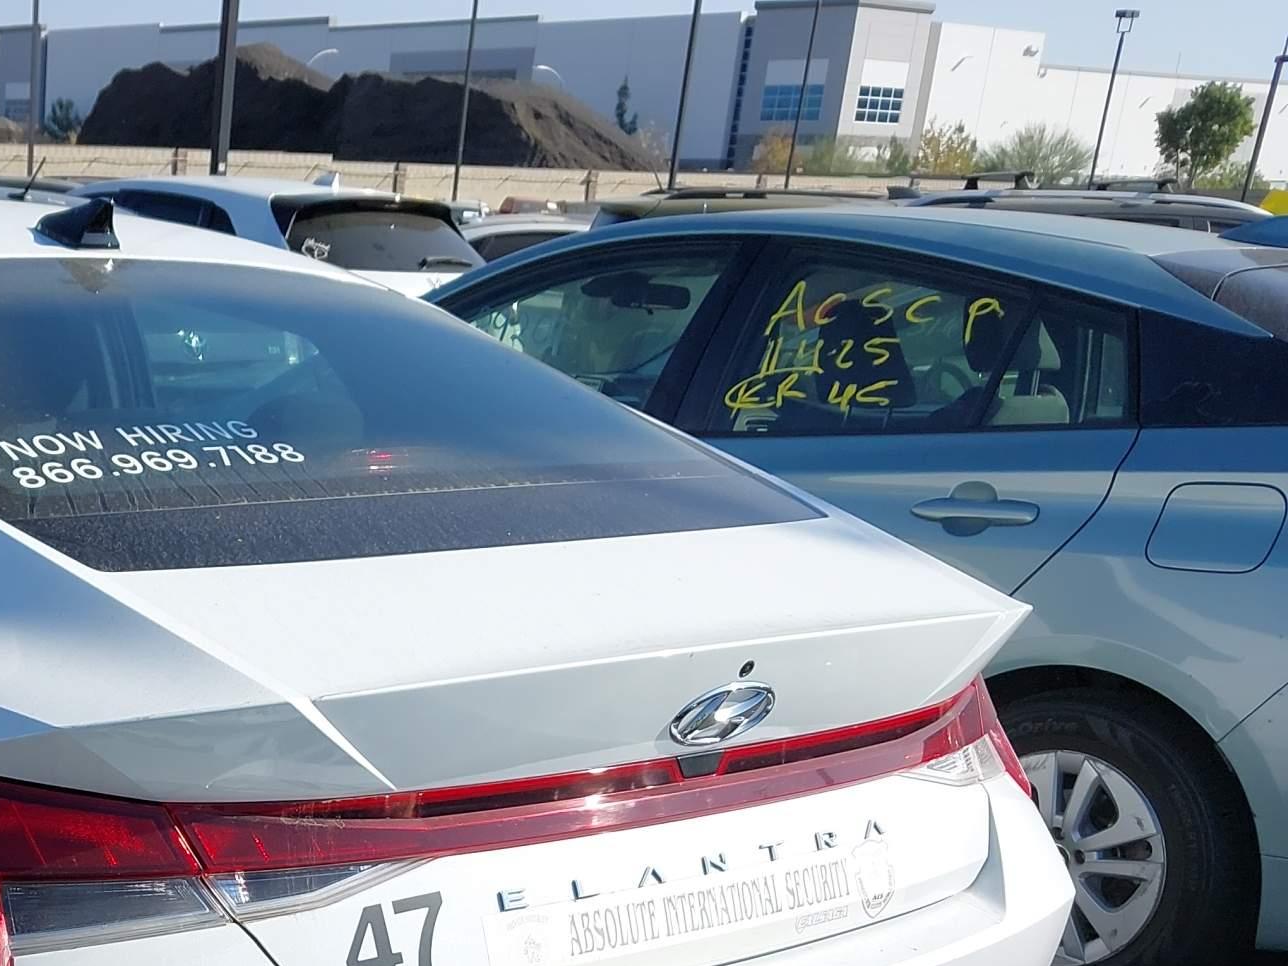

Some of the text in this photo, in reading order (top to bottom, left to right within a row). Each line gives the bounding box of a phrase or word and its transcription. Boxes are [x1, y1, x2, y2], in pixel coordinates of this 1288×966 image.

[12, 443, 305, 489] 866.969.7188
[116, 420, 259, 447] HIRING
[497, 819, 886, 912] ELANTRA
[569, 900, 660, 957] ABSOLUTE
[664, 872, 784, 937] INTERNATIONAL
[785, 857, 850, 910] SECURITY
